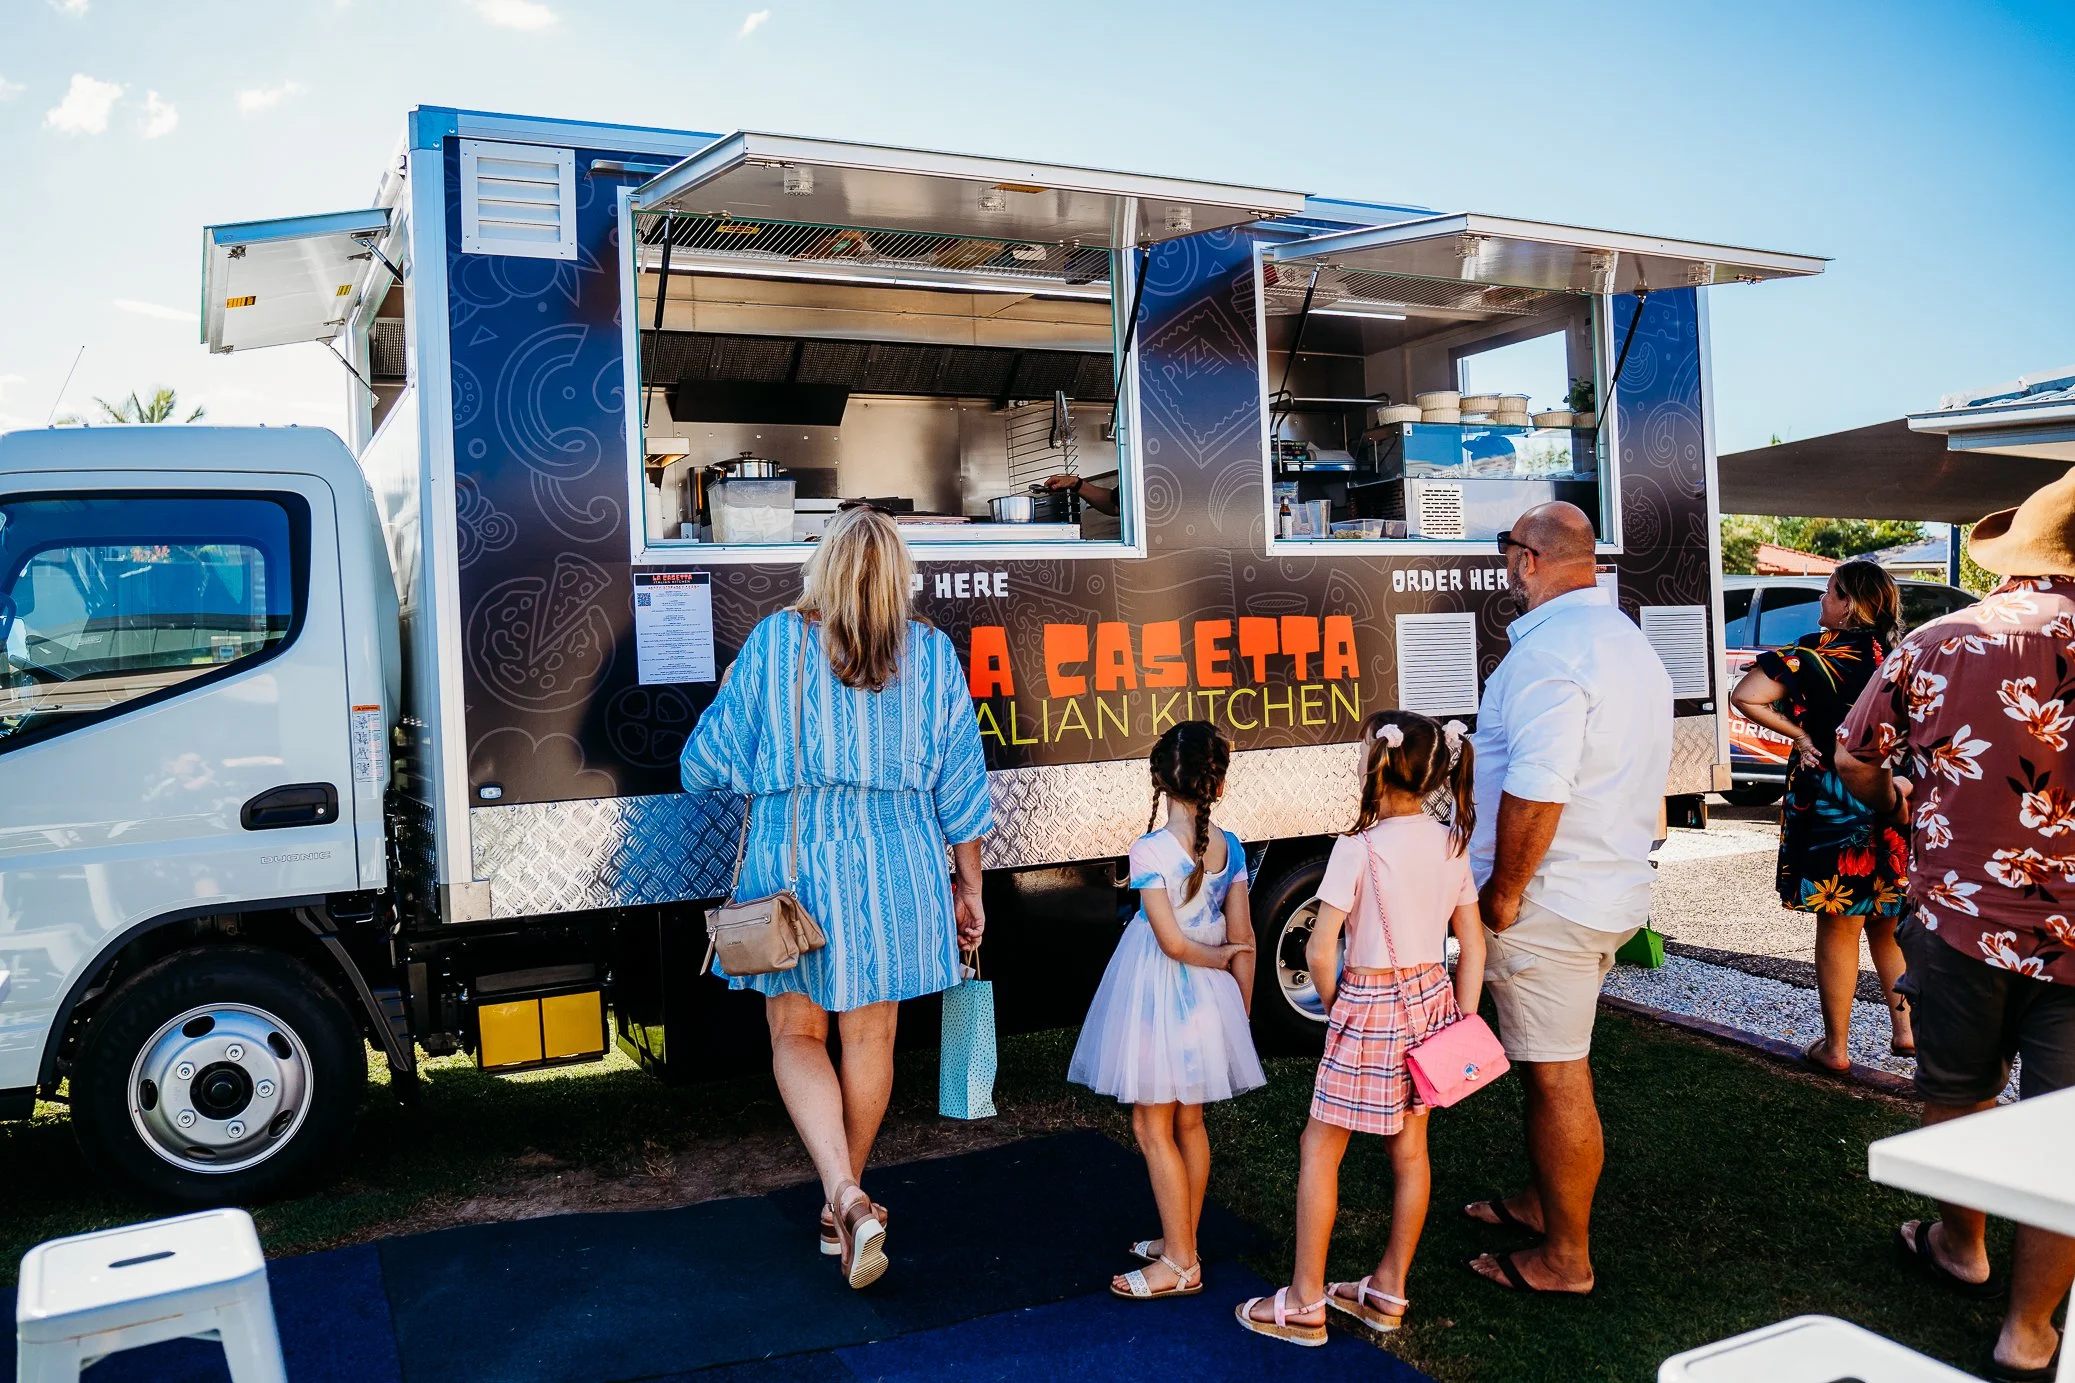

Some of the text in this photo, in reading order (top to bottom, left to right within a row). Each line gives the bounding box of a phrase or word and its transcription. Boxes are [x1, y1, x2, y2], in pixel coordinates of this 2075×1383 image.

[935, 572, 1008, 598] HERE
[1391, 568, 1510, 593] ORDER HER
[969, 615, 1360, 699] A CASETTA
[977, 682, 1360, 746] ALIAN KITCHEN
